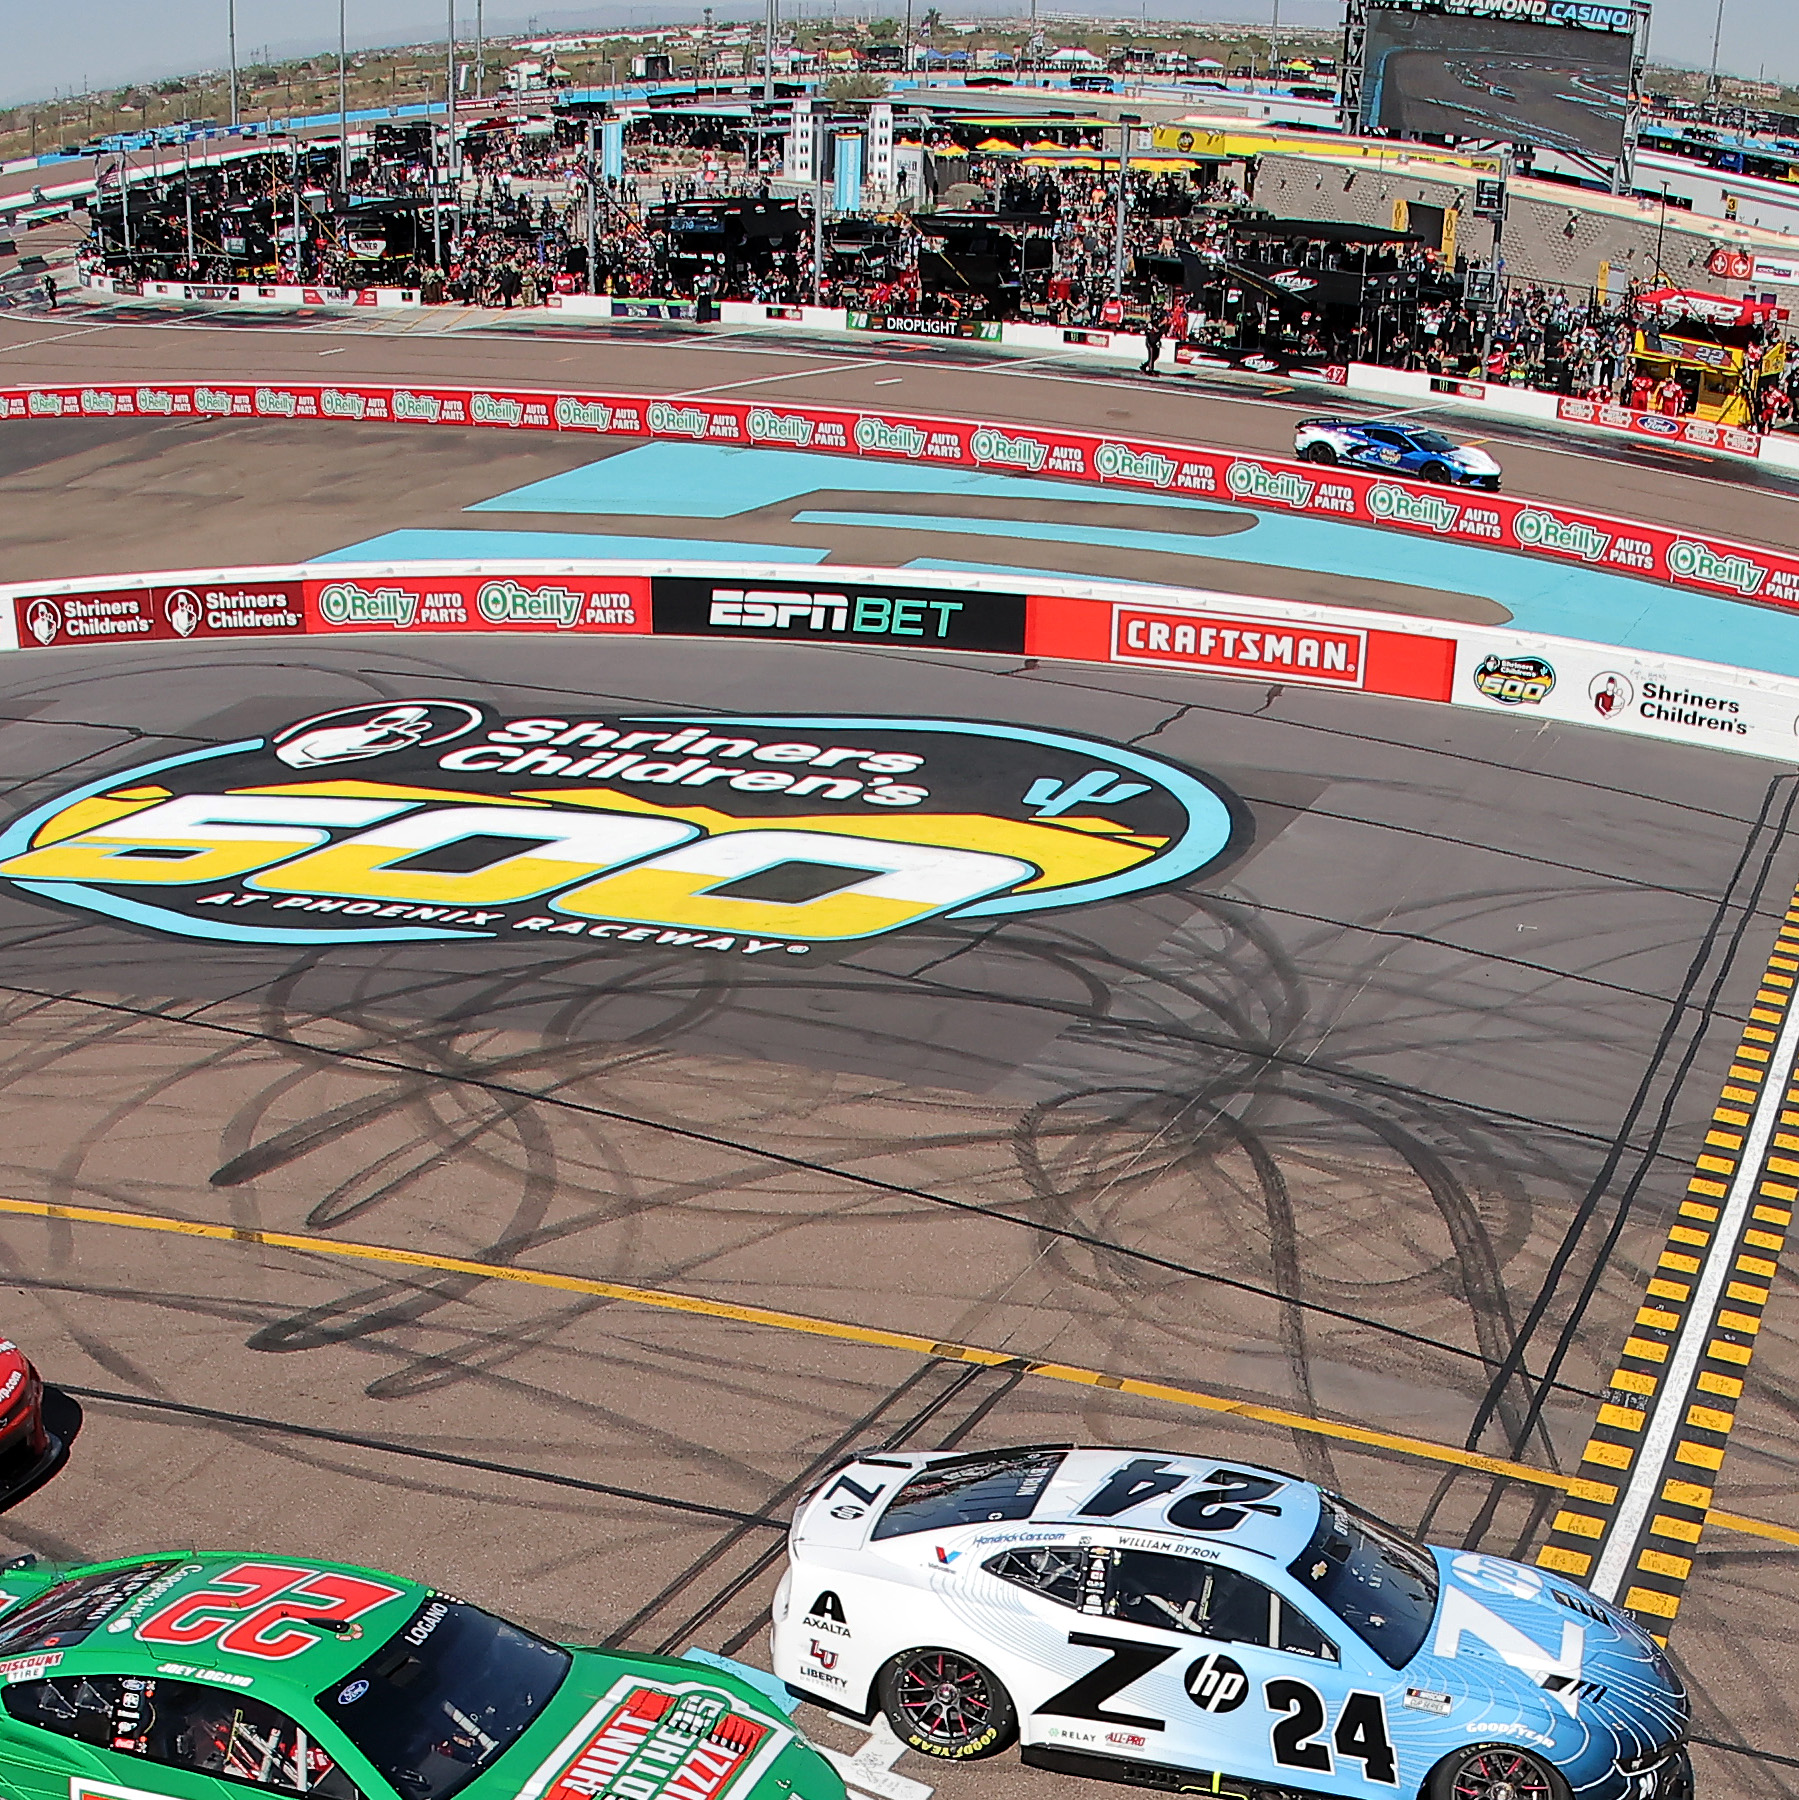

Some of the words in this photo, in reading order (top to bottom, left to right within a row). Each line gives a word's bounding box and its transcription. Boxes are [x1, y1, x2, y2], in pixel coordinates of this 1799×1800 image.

[1465, 0, 1547, 18] DIAMOND
[1551, 2, 1629, 27] CASINO
[851, 312, 869, 328] 78
[886, 317, 958, 335] DROPLIGHT
[980, 322, 1000, 338] 78
[1325, 367, 1347, 384] 47
[1229, 462, 1312, 508] O'Reilly
[1319, 484, 1353, 501] AUTO
[1313, 495, 1355, 515] PARTS
[1518, 507, 1607, 558] O'Reilly
[1615, 537, 1651, 555] AUTO
[1610, 548, 1654, 570] PARTS
[64, 599, 140, 617] Shriners
[206, 591, 287, 610] Shriners
[322, 583, 417, 625] O'Reilly
[425, 592, 463, 608] AUTO
[479, 582, 582, 627] O'Reilly
[590, 593, 630, 608] AUTO
[710, 590, 849, 630] ESPN
[853, 598, 964, 637] BET
[66, 616, 150, 635] Children's
[207, 609, 297, 628] Children's
[422, 608, 467, 623] PARTS
[587, 609, 634, 624] PARTS
[1127, 620, 1348, 673] CRAFTSMAN
[1502, 659, 1534, 672] Shriners
[1480, 676, 1547, 703] 500
[1642, 682, 1740, 714] Shriners
[1640, 701, 1748, 735] Children's
[484, 717, 926, 773] Shriners
[438, 746, 930, 807] Children's
[196, 893, 268, 908] AT
[272, 896, 504, 927] PHOENIX
[514, 916, 782, 954] RACEWAY
[1074, 1458, 1286, 1533] 24
[1118, 1536, 1170, 1553] WILLIAM
[1176, 1543, 1220, 1561] BYRON
[134, 1563, 406, 1662] 22
[404, 1602, 450, 1648] LOGANO
[803, 1616, 853, 1638] AXALTA
[12, 1668, 40, 1679] TIRE
[156, 1662, 193, 1679] JOEY
[195, 1667, 255, 1689] LOGANO
[800, 1666, 848, 1689] LIBERTY
[1032, 1631, 1184, 1732] Z
[1189, 1653, 1246, 1713] hp
[909, 1727, 998, 1758] GOODYEAR
[1060, 1729, 1097, 1743] RELAY
[1262, 1676, 1401, 1788] 24
[1466, 1721, 1556, 1749] GOODYEAR
[560, 1709, 660, 1795] HUNT
